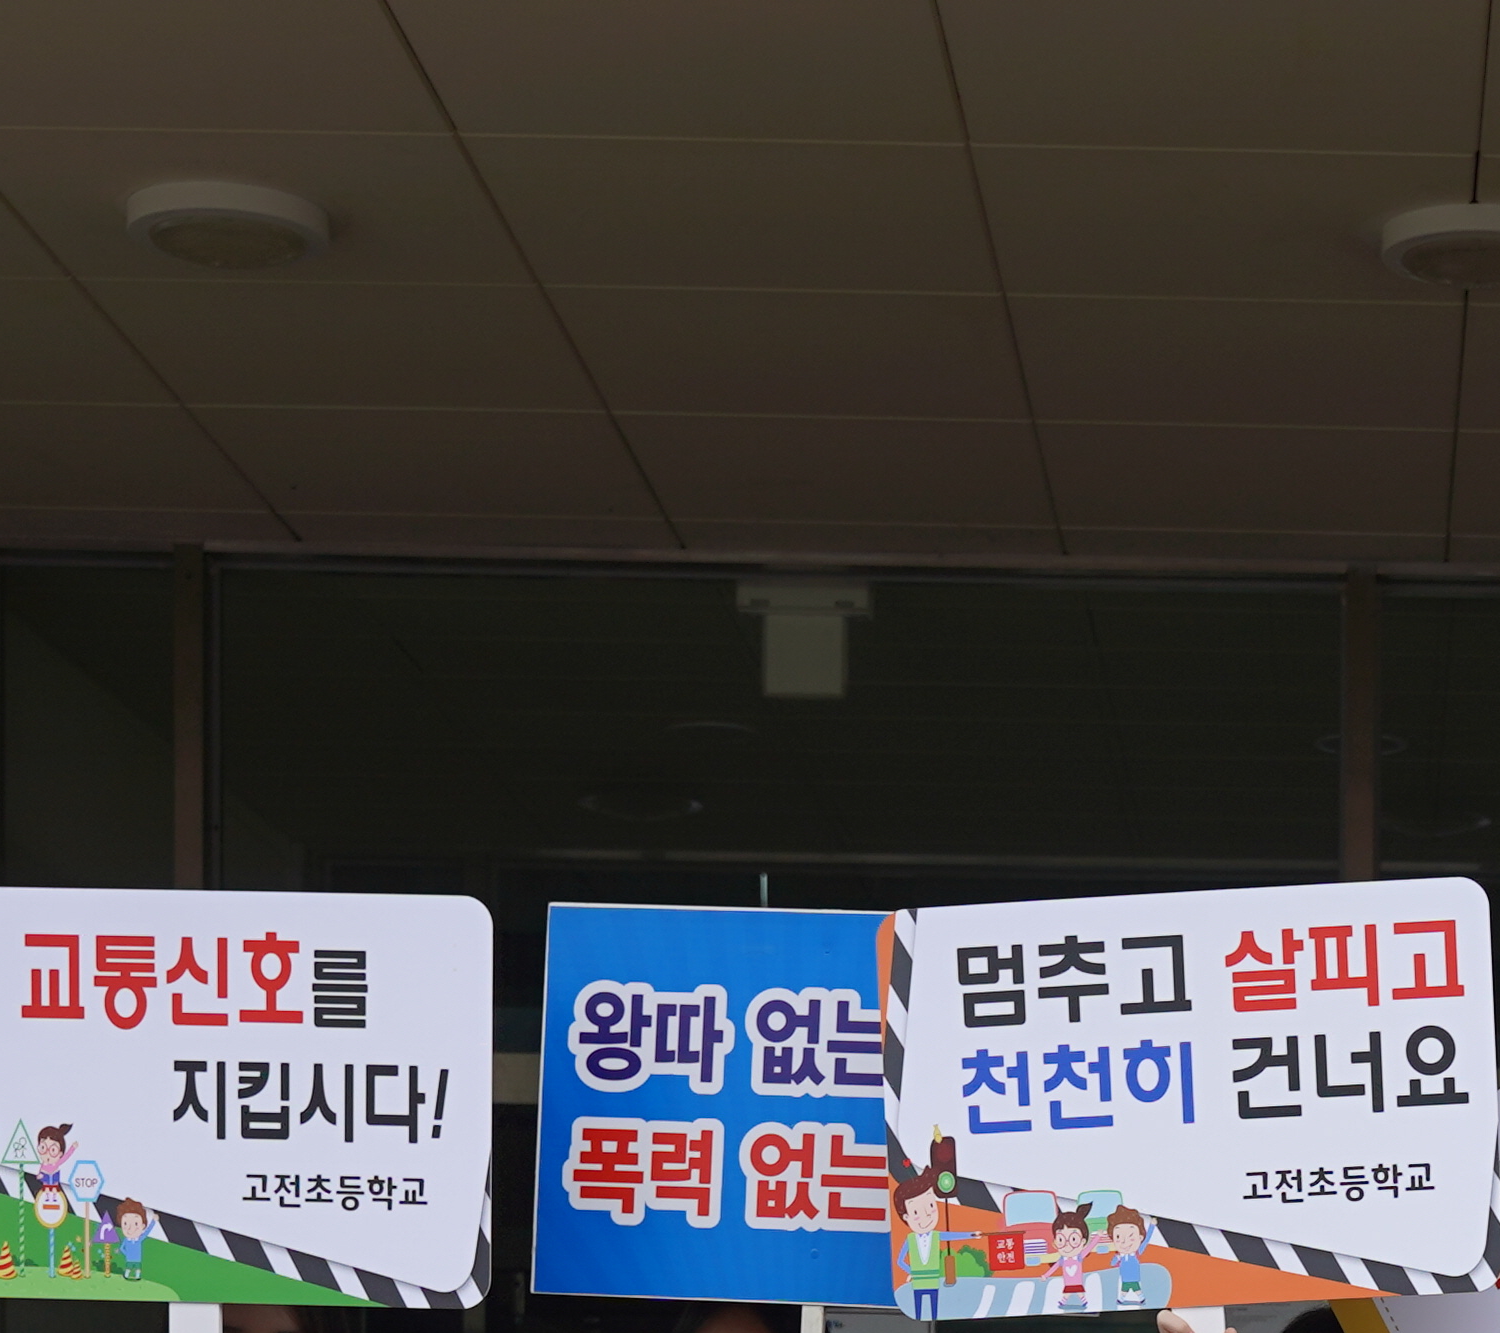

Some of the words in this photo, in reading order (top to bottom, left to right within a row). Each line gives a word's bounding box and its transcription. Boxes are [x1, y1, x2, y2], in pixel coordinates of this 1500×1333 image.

[21, 931, 369, 1030] 교통신호를
[956, 933, 1194, 1029] 멈추고
[1224, 918, 1465, 1013] 살피고
[579, 990, 724, 1084] 왕따
[756, 996, 885, 1088] 없는
[961, 1038, 1196, 1135] 천천히
[1230, 1024, 1470, 1120] 건너요
[173, 1060, 449, 1143] 지킵시다!
[74, 1176, 98, 1189] STOP
[242, 1173, 428, 1211] 고전초등학교
[571, 1126, 714, 1217] 폭력
[748, 1132, 888, 1223] 없는
[1242, 1161, 1436, 1205] 고전초등학교
[996, 1238, 1015, 1250] 교통
[996, 1251, 1016, 1264] 안전
